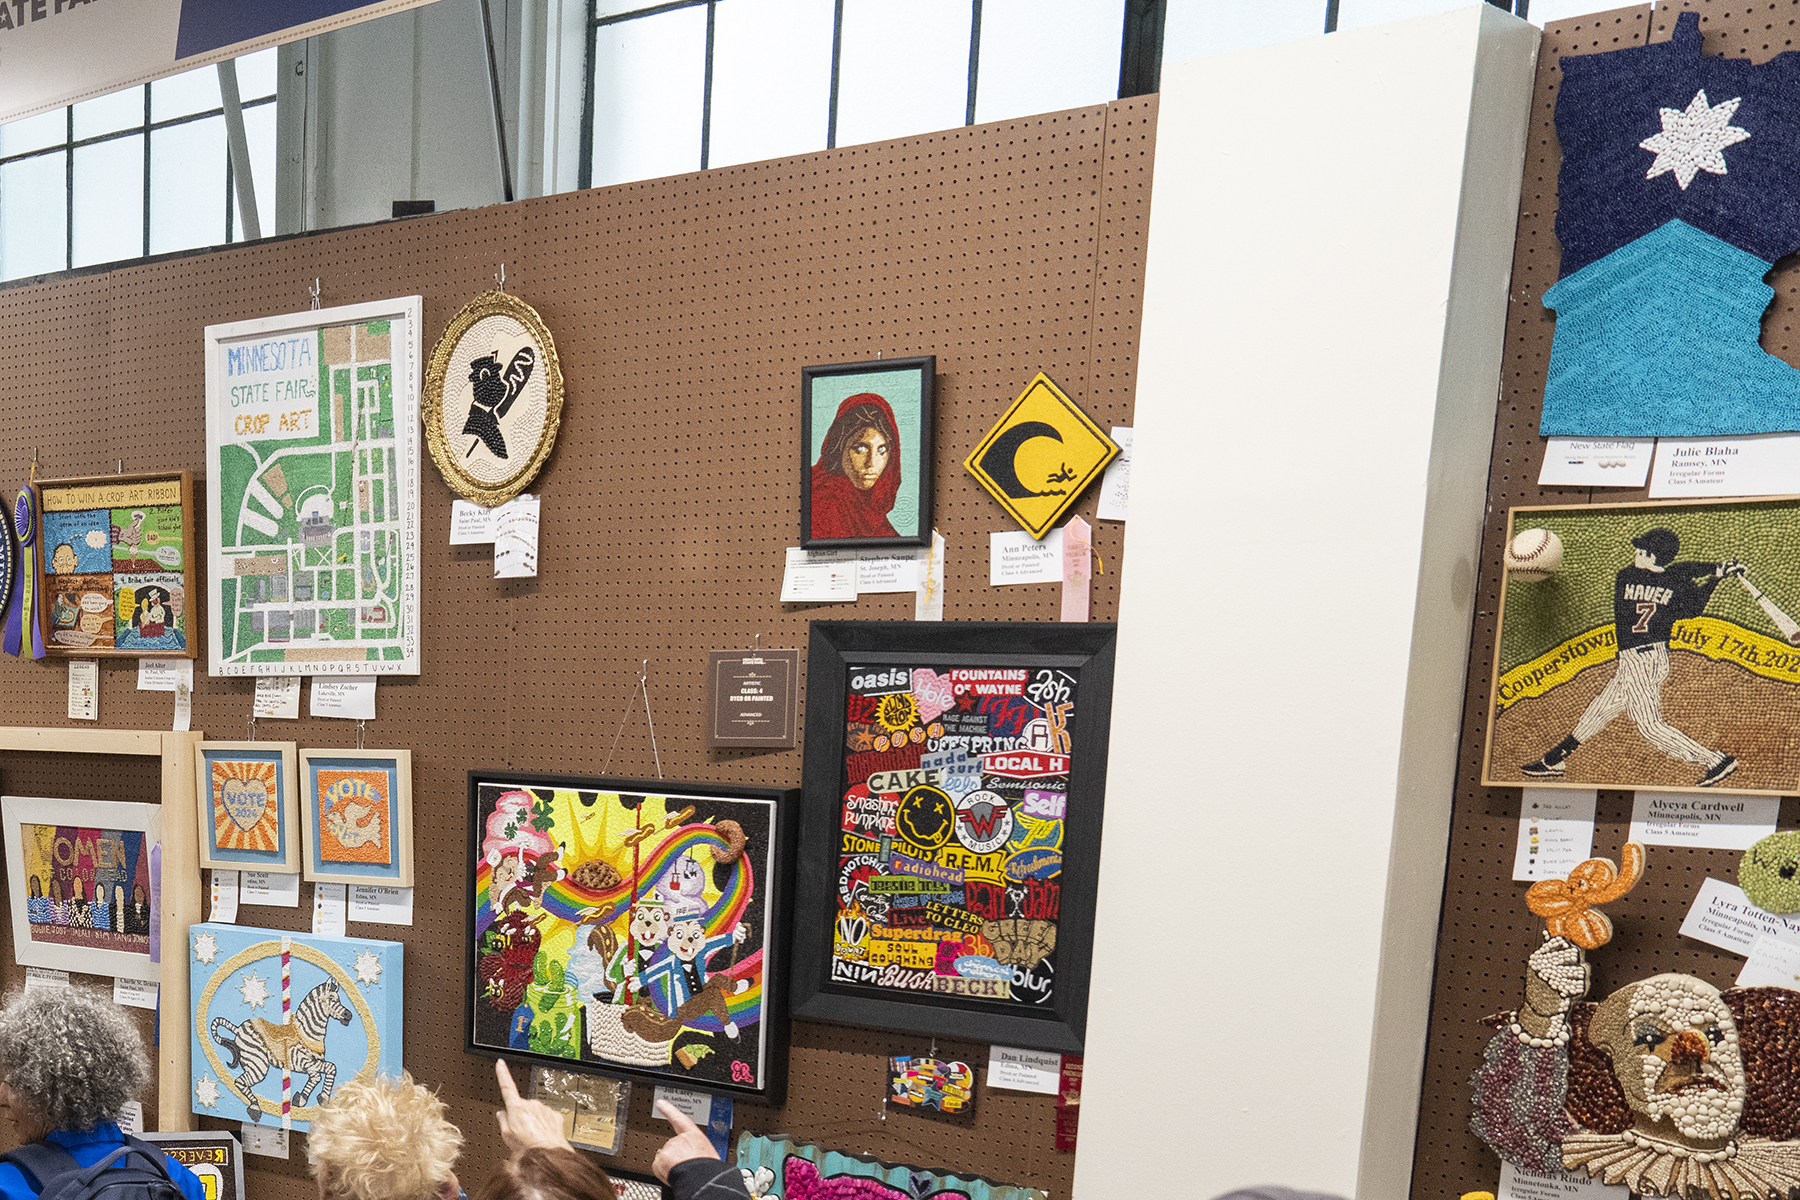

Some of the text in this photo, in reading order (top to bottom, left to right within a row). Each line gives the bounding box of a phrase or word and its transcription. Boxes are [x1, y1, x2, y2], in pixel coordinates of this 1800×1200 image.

[227, 338, 312, 377] MINNESOTA
[230, 378, 309, 408] STATE FAIR
[234, 409, 313, 436] CROP ART
[1570, 441, 1636, 450] New State Flag
[1673, 446, 1739, 457] Julie Blaha
[1671, 459, 1708, 468] Ramsey,
[47, 488, 176, 505] HOW TO WIN A CROP ART RIBBON
[459, 510, 476, 518] Becky
[1002, 543, 1047, 554] Ann Peters
[859, 554, 915, 565] Stephen Saupe
[1001, 552, 1055, 564] Minneapolis, MN
[1623, 583, 1674, 605] MAUER
[1631, 603, 1656, 633] 7
[1498, 628, 1617, 700] Cooperstown
[1669, 625, 1713, 650] July
[851, 668, 908, 690] oasis
[952, 669, 1027, 681] FOUNTAINS
[915, 677, 952, 708] Hole
[975, 684, 1022, 695] WAYNE
[848, 694, 878, 724] U2
[942, 714, 988, 724] RAGE AGAINST
[944, 724, 987, 734] THE MACHINE
[927, 735, 1029, 754] OFFSPRING
[921, 752, 967, 770] nada
[948, 760, 983, 774] surf
[985, 757, 1063, 771] LOCAL H
[868, 769, 940, 791] CAKE
[987, 777, 1066, 791] Semisonic
[226, 791, 265, 807] VOTE
[326, 778, 380, 803] VOTE
[967, 792, 996, 804] ROCK
[235, 807, 259, 819] 2024
[1025, 793, 1066, 817] Self
[1649, 799, 1744, 813] Alycya Cardwell
[1648, 811, 1722, 822] Minneapolis, MN
[842, 834, 881, 853] STONE
[968, 837, 1002, 850] MUSIC
[893, 859, 964, 883] radiohead
[945, 852, 995, 873] R.E.M.
[355, 886, 399, 895] Jennifer O'Brien
[839, 877, 852, 904] RED
[1711, 895, 1739, 912] Lyra
[925, 901, 985, 926] LETTERS
[925, 910, 980, 934] TO CLEO
[1705, 906, 1778, 937] Minneapolis, MN
[840, 915, 867, 946] NO
[871, 924, 963, 944] Superdrag
[1701, 915, 1754, 938] Irregular Forms
[887, 943, 918, 954] SOUL
[870, 953, 934, 967] COUGHING
[1012, 964, 1051, 993] blur
[934, 978, 1008, 999] BECK!
[1001, 1052, 1059, 1067] Dan Lindquist
[1512, 1176, 1580, 1194] Minnetonka, MN
[1513, 1165, 1593, 1187] Nicholas Rindo
